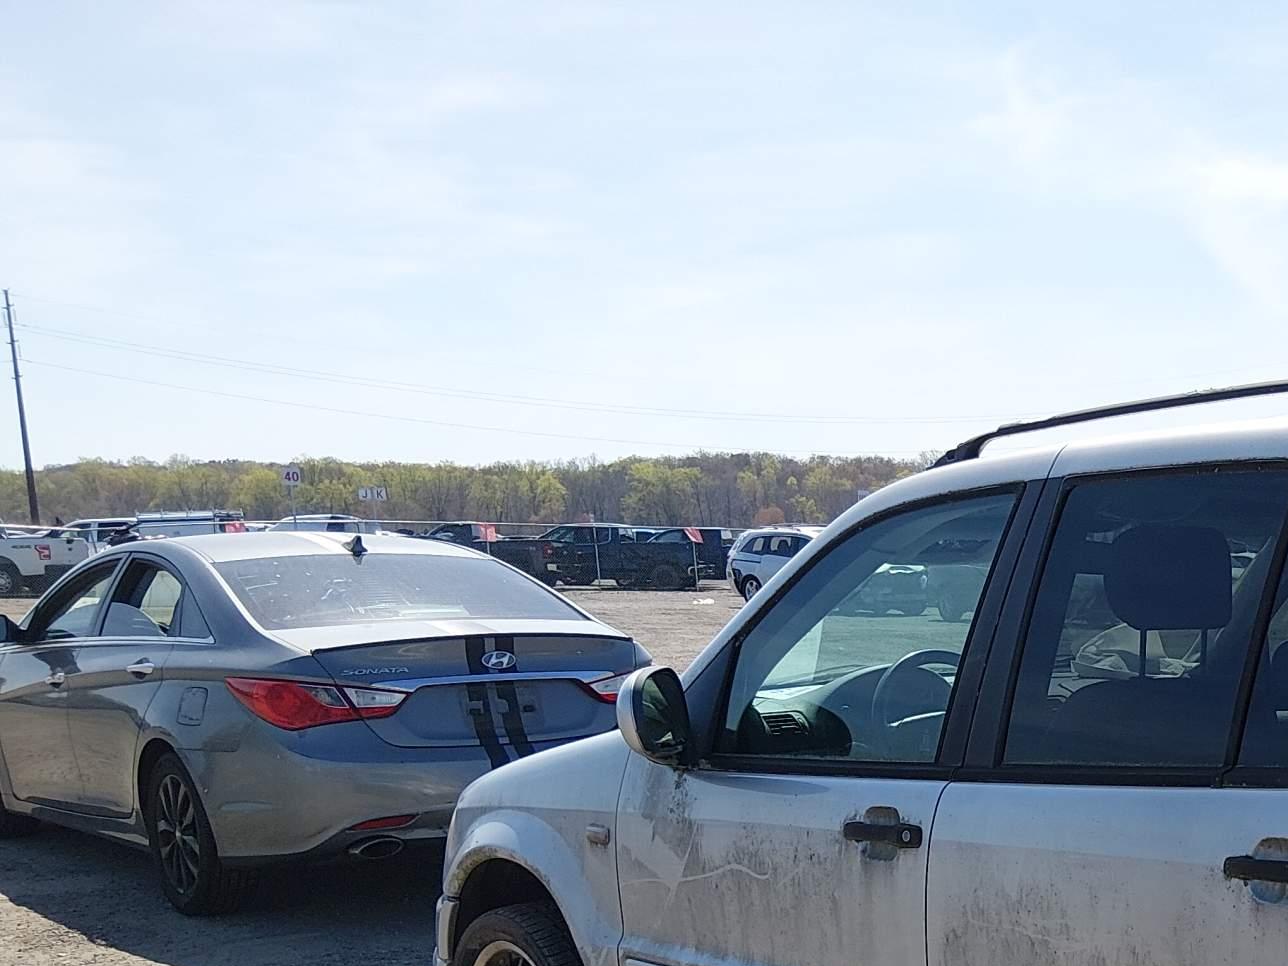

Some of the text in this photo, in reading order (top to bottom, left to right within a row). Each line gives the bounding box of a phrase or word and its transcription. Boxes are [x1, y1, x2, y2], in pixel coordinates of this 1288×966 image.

[284, 471, 300, 482] 40
[362, 489, 384, 499] J K
[340, 667, 409, 676] SONATA
